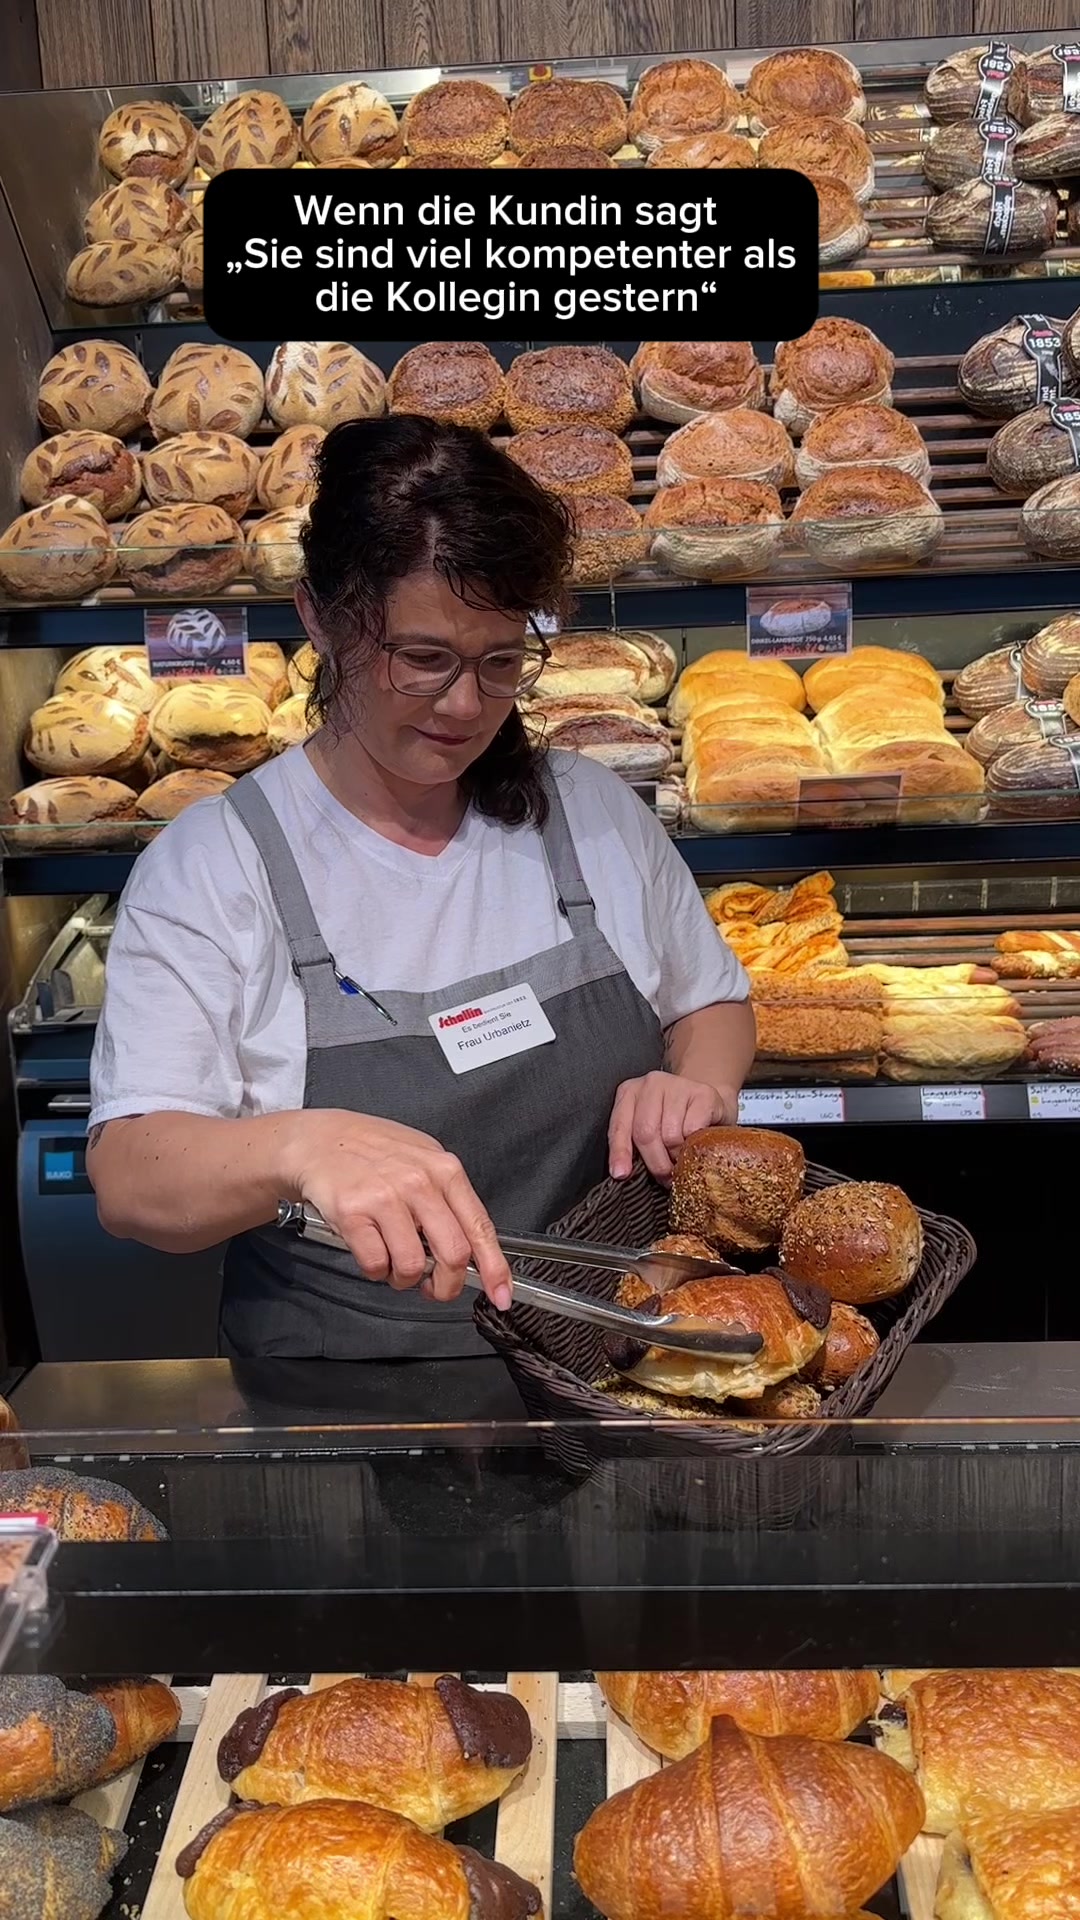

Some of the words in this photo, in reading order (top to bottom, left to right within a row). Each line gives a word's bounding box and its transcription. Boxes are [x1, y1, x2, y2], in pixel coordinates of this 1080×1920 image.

[1028, 337, 1061, 349] 1853
[457, 1036, 482, 1050] Frau
[483, 1018, 532, 1041] Urbanietz
[461, 1025, 472, 1034] Es
[472, 1014, 498, 1030] bedient
[498, 1011, 512, 1021] Sie
